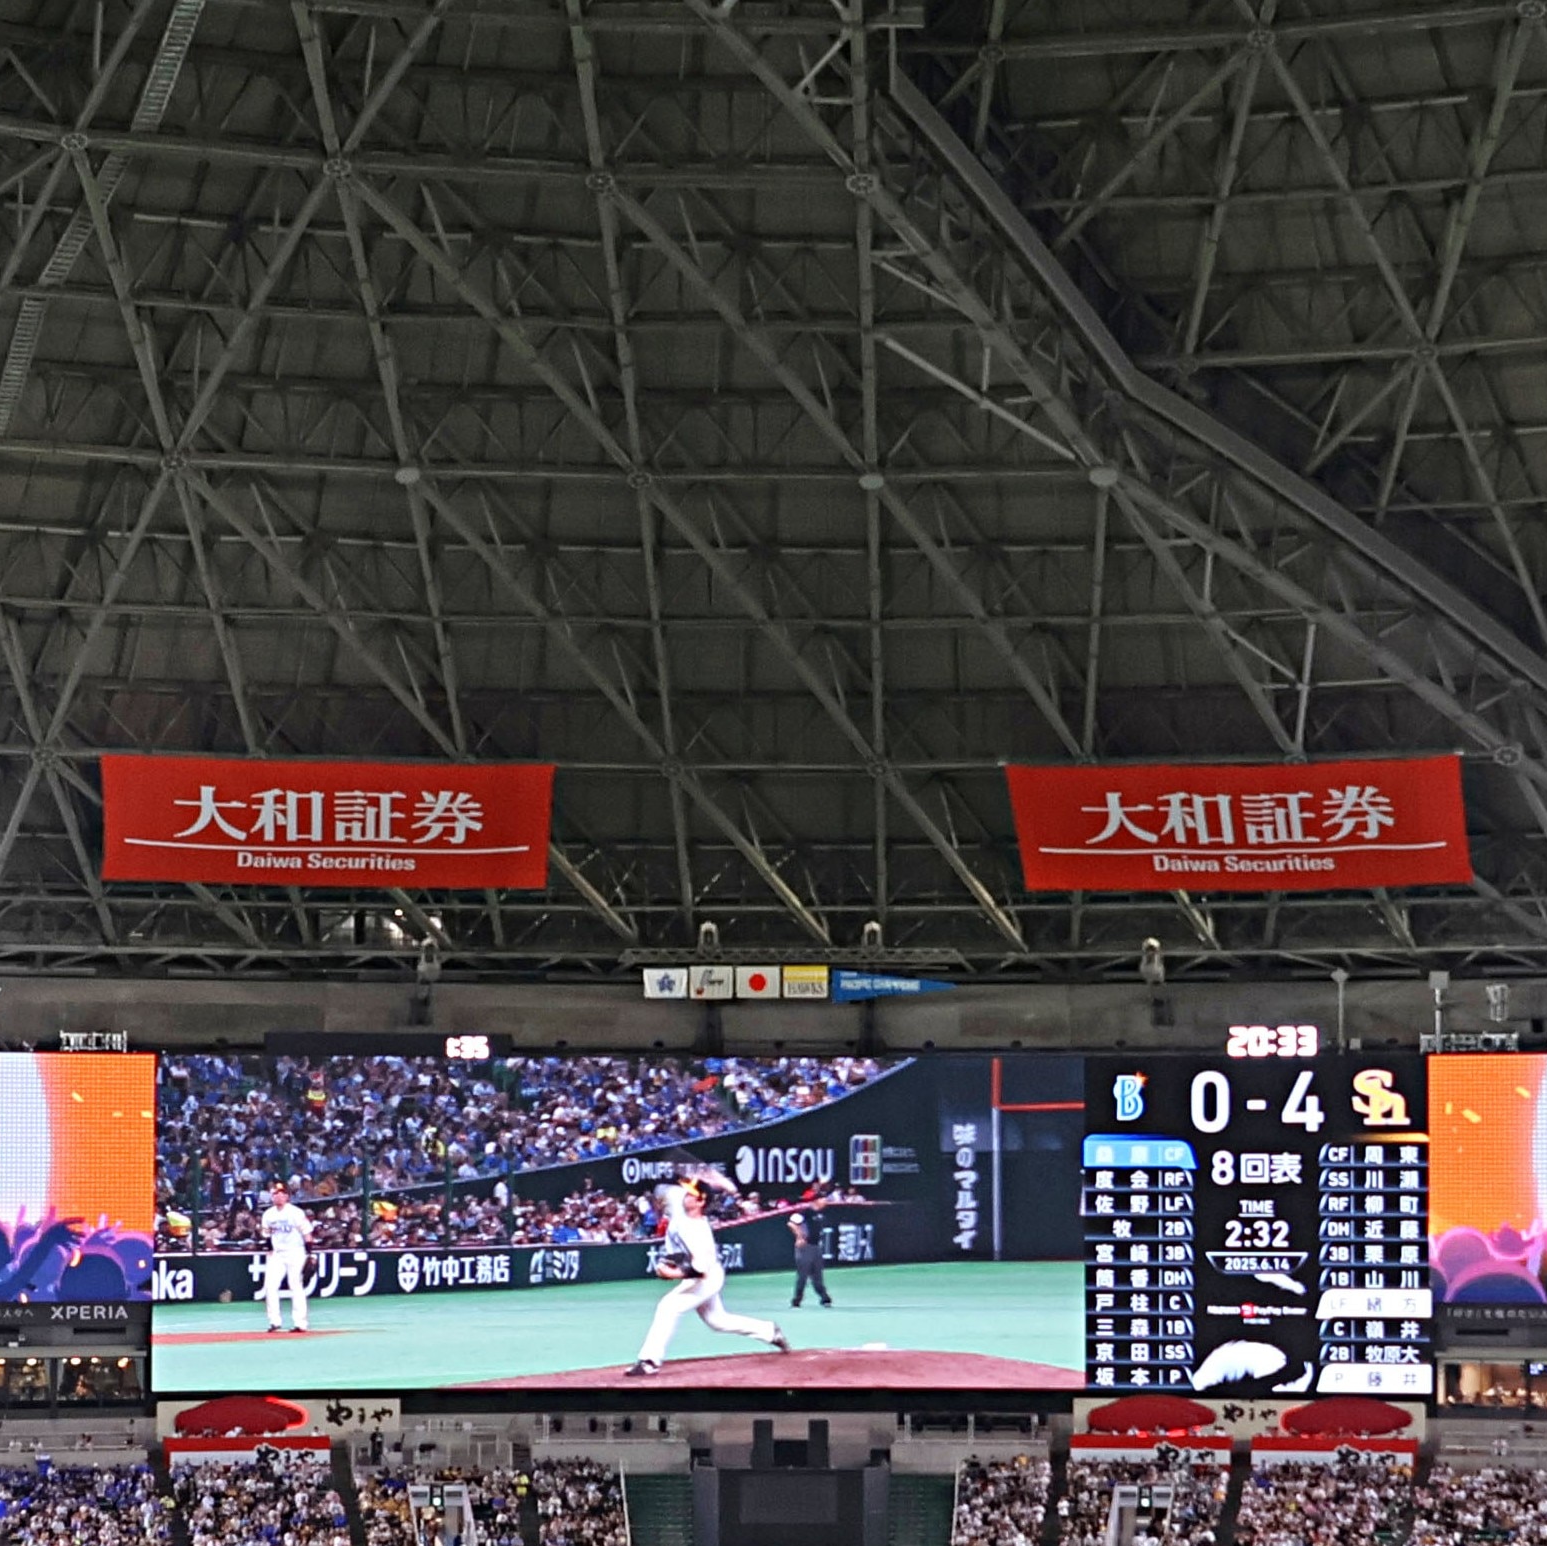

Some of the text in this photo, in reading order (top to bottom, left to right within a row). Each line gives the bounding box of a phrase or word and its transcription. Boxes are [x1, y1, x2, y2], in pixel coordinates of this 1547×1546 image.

[173, 786, 484, 845] 大和証券
[1081, 785, 1395, 845] 大和証券
[237, 852, 416, 872] Daiwa Securities
[1154, 853, 1335, 873] Daiwa Securities
[1190, 1070, 1230, 1133] 0
[1281, 1070, 1325, 1133] 4
[1328, 1147, 1348, 1162] CF
[1211, 1150, 1303, 1186] 8回表
[1164, 1172, 1185, 1187] RF
[1328, 1172, 1349, 1187] SS
[1165, 1196, 1185, 1211] LF
[1239, 1200, 1274, 1215] TIME
[1328, 1196, 1349, 1211] RF
[1165, 1221, 1185, 1236] 2B
[1225, 1220, 1290, 1248] 2:32
[1328, 1221, 1350, 1236] DH
[1165, 1246, 1185, 1261] 3B
[1329, 1246, 1349, 1261] 3B
[1225, 1257, 1291, 1272] 2025.6.14
[1164, 1271, 1185, 1286] DH
[1330, 1270, 1418, 1289] 1B 山川
[1169, 1295, 1181, 1310] C
[50, 1305, 128, 1320] XPERIA
[1165, 1320, 1185, 1335] 1B
[1334, 1322, 1345, 1336] C
[1164, 1345, 1185, 1360] SS
[1329, 1346, 1349, 1361] 2B
[1170, 1370, 1181, 1384] P
